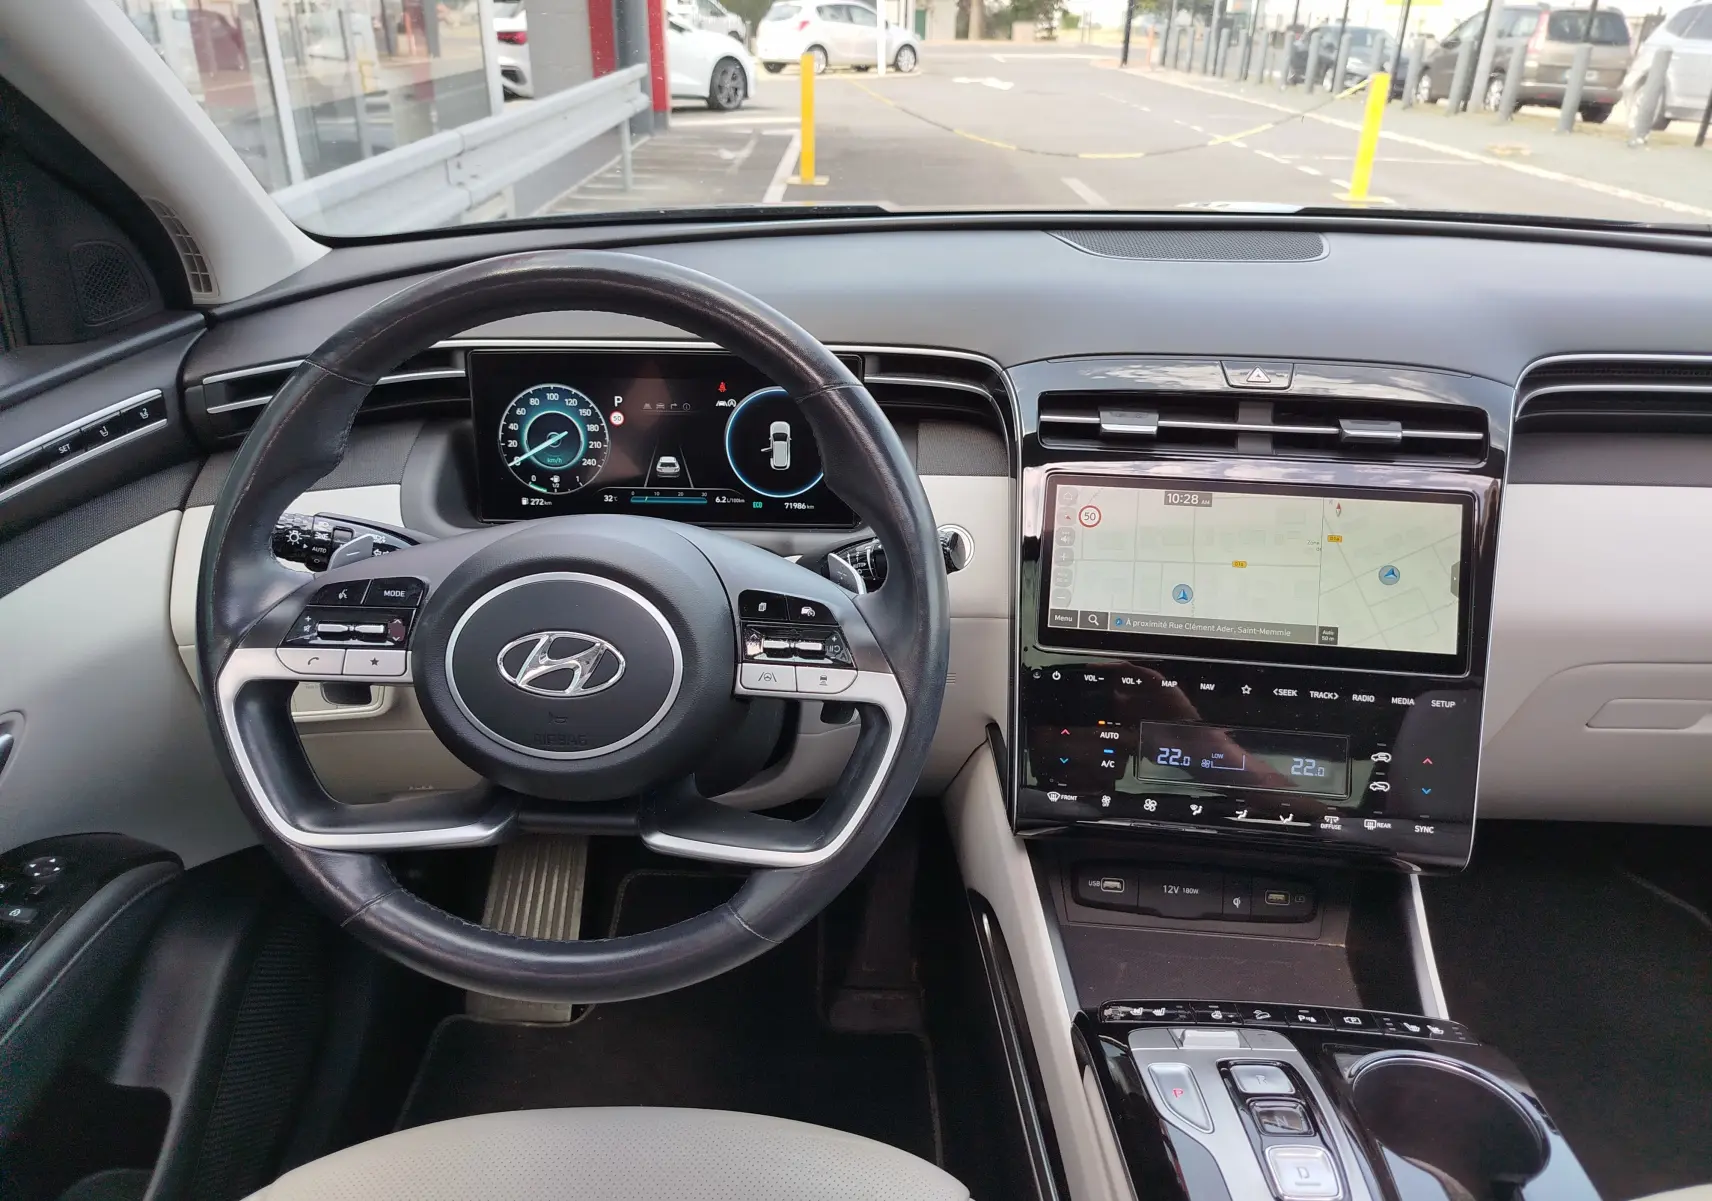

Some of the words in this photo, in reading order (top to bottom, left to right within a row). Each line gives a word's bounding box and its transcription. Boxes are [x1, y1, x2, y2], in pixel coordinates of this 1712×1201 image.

[546, 393, 559, 401] 100
[565, 398, 578, 406] 120
[614, 396, 623, 407] P
[579, 409, 591, 417] 150
[508, 423, 518, 431] 40
[586, 424, 599, 432] 180
[507, 440, 518, 448] 20
[58, 444, 71, 454] SET
[582, 458, 596, 466] 240
[531, 474, 537, 482] 0
[1166, 493, 1199, 505] 10:28
[753, 501, 763, 509] ECO
[784, 502, 806, 510] 71986
[1083, 512, 1096, 521] 50
[312, 546, 327, 554] AUTO
[1055, 614, 1072, 622] Menu
[1132, 620, 1168, 630] proximité
[1185, 622, 1215, 632] Clément
[1216, 625, 1236, 634] Ader,
[1161, 680, 1177, 688] MAP
[1200, 683, 1215, 691] NAV
[1352, 694, 1375, 703] RADIO
[1391, 697, 1415, 705] MEDIA
[1431, 700, 1456, 708] SETUP
[1100, 732, 1119, 740] AUTO
[1157, 747, 1191, 766] 22.0
[1101, 760, 1115, 768] A/C
[1291, 758, 1325, 776] 22.0
[1320, 823, 1342, 831] DIFFUSE
[1414, 825, 1434, 834] SYNC
[1163, 885, 1180, 894] 12V
[1182, 887, 1199, 895] 180W
[1171, 1087, 1184, 1099] P
[1296, 1166, 1310, 1179] D
